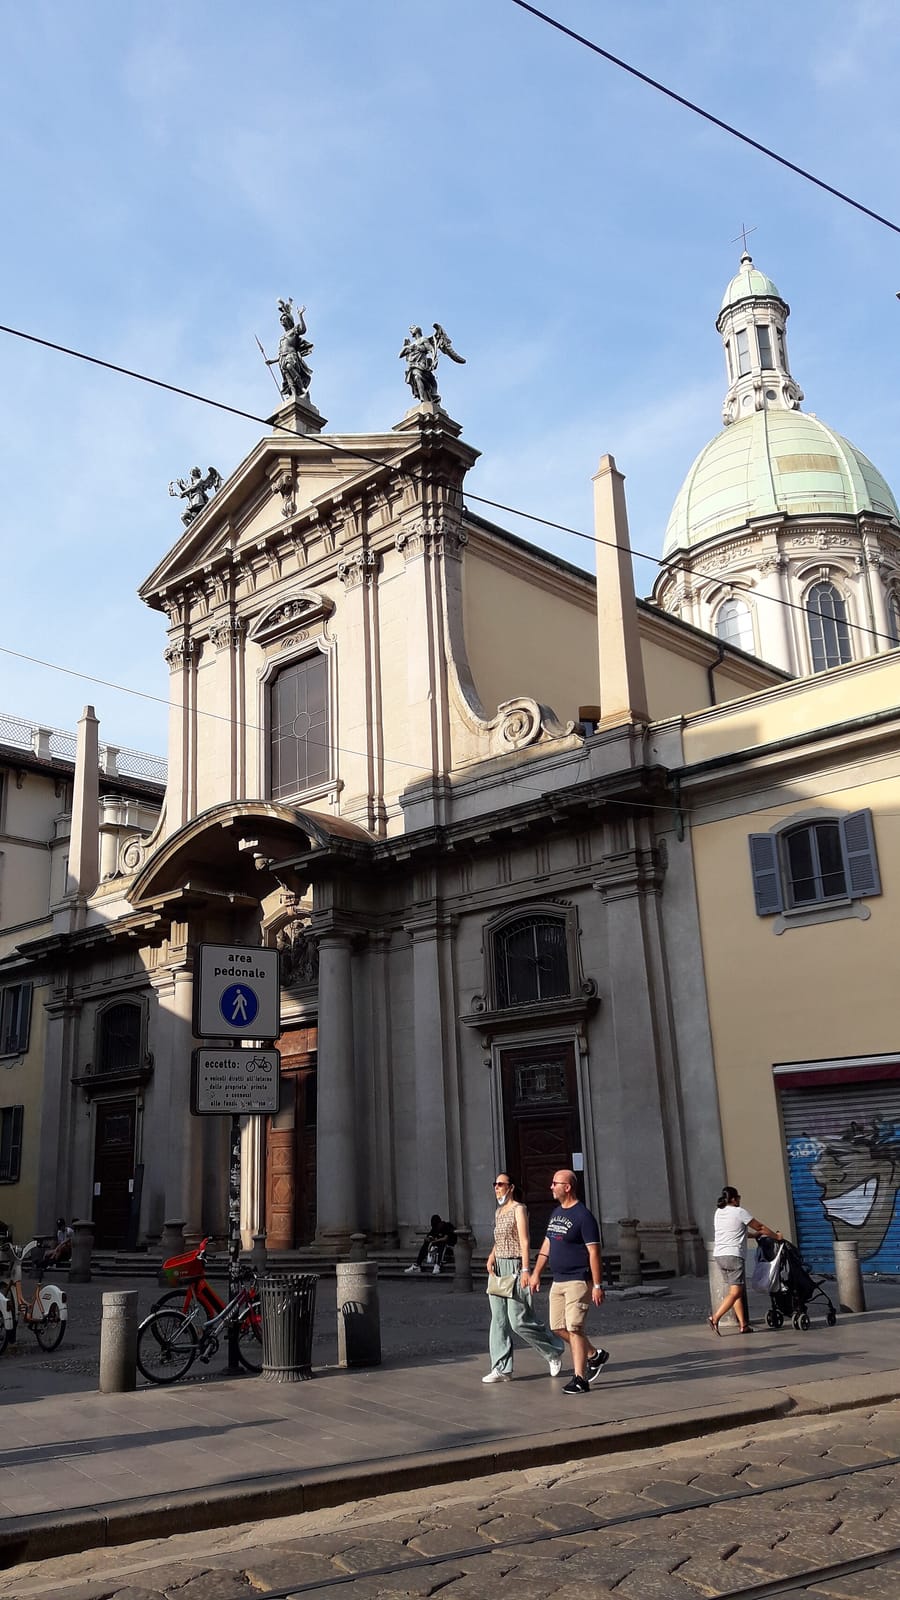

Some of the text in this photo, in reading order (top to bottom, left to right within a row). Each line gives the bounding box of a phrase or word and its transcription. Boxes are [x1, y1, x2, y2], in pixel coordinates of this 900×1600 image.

[228, 954, 252, 963] area
[214, 967, 266, 978] pedonale
[205, 1059, 240, 1069] eccetto:
